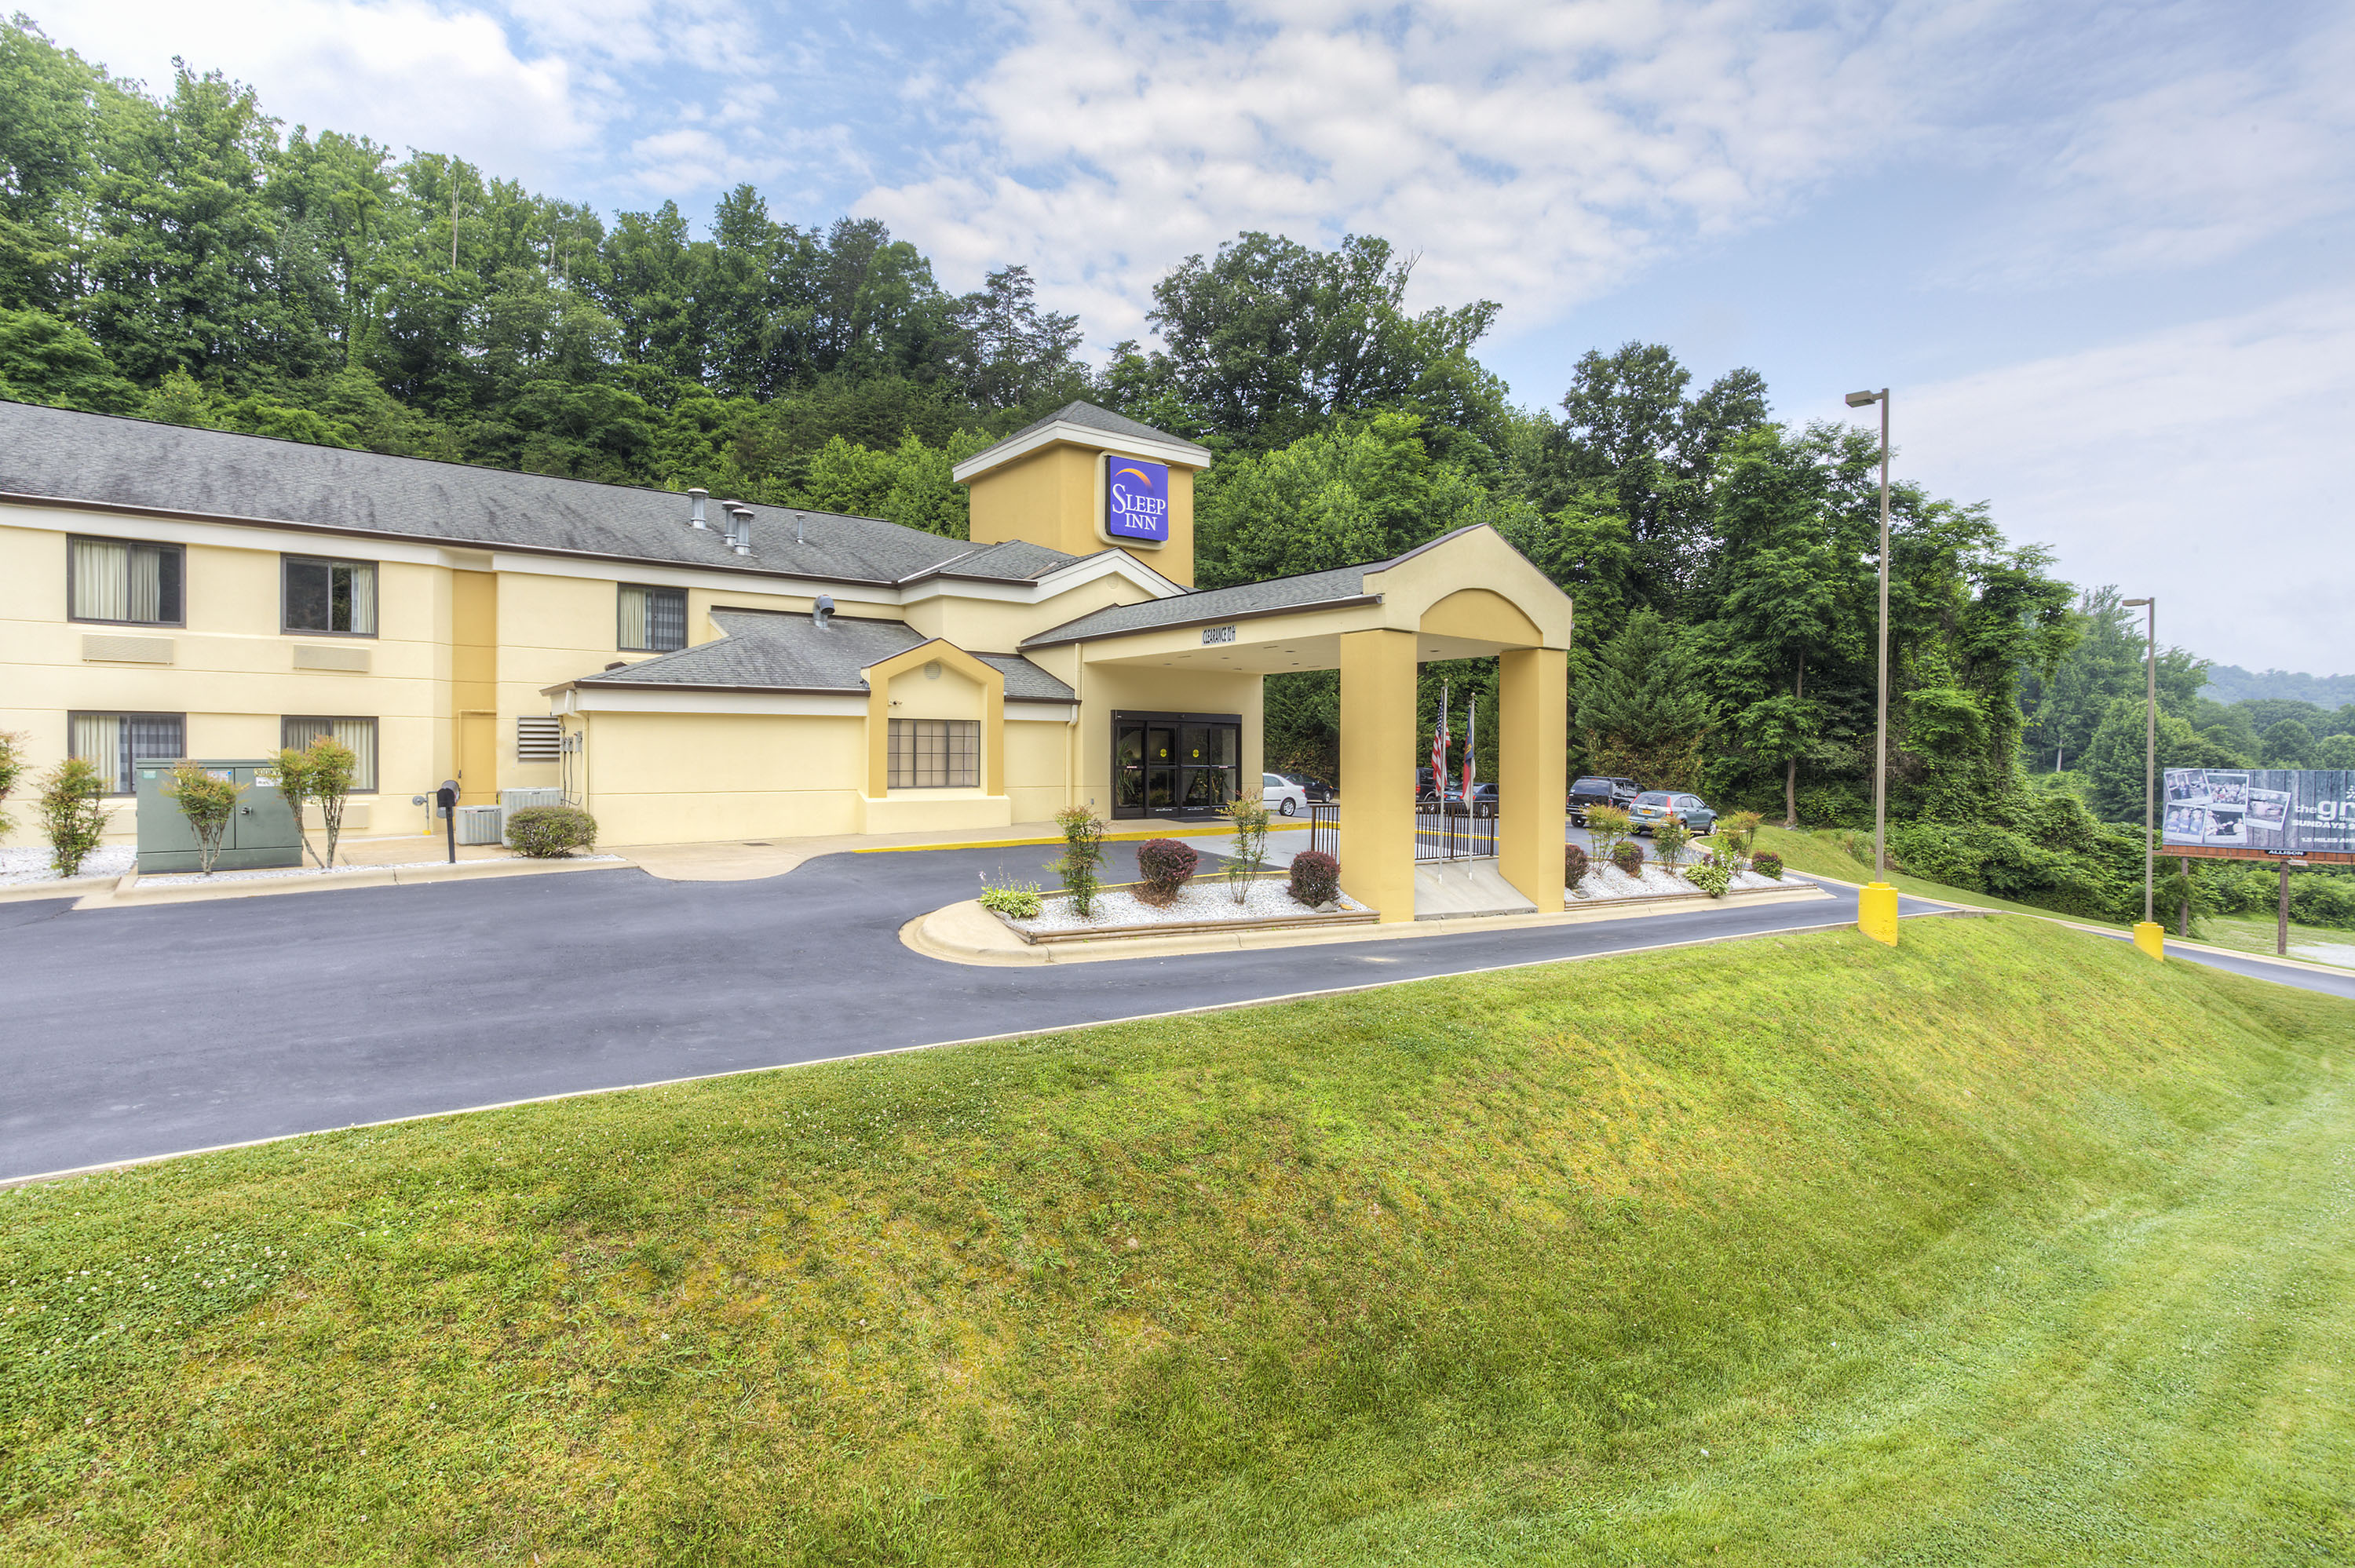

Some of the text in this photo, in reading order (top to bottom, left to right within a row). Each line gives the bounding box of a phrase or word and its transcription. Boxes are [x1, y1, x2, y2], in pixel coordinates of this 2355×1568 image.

[1112, 483, 1166, 516] SLEEP
[1124, 512, 1158, 531] INN
[1203, 627, 1226, 644] CLEARANCE
[2295, 804, 2317, 814] the
[2291, 819, 2346, 830] SUNDAYS
